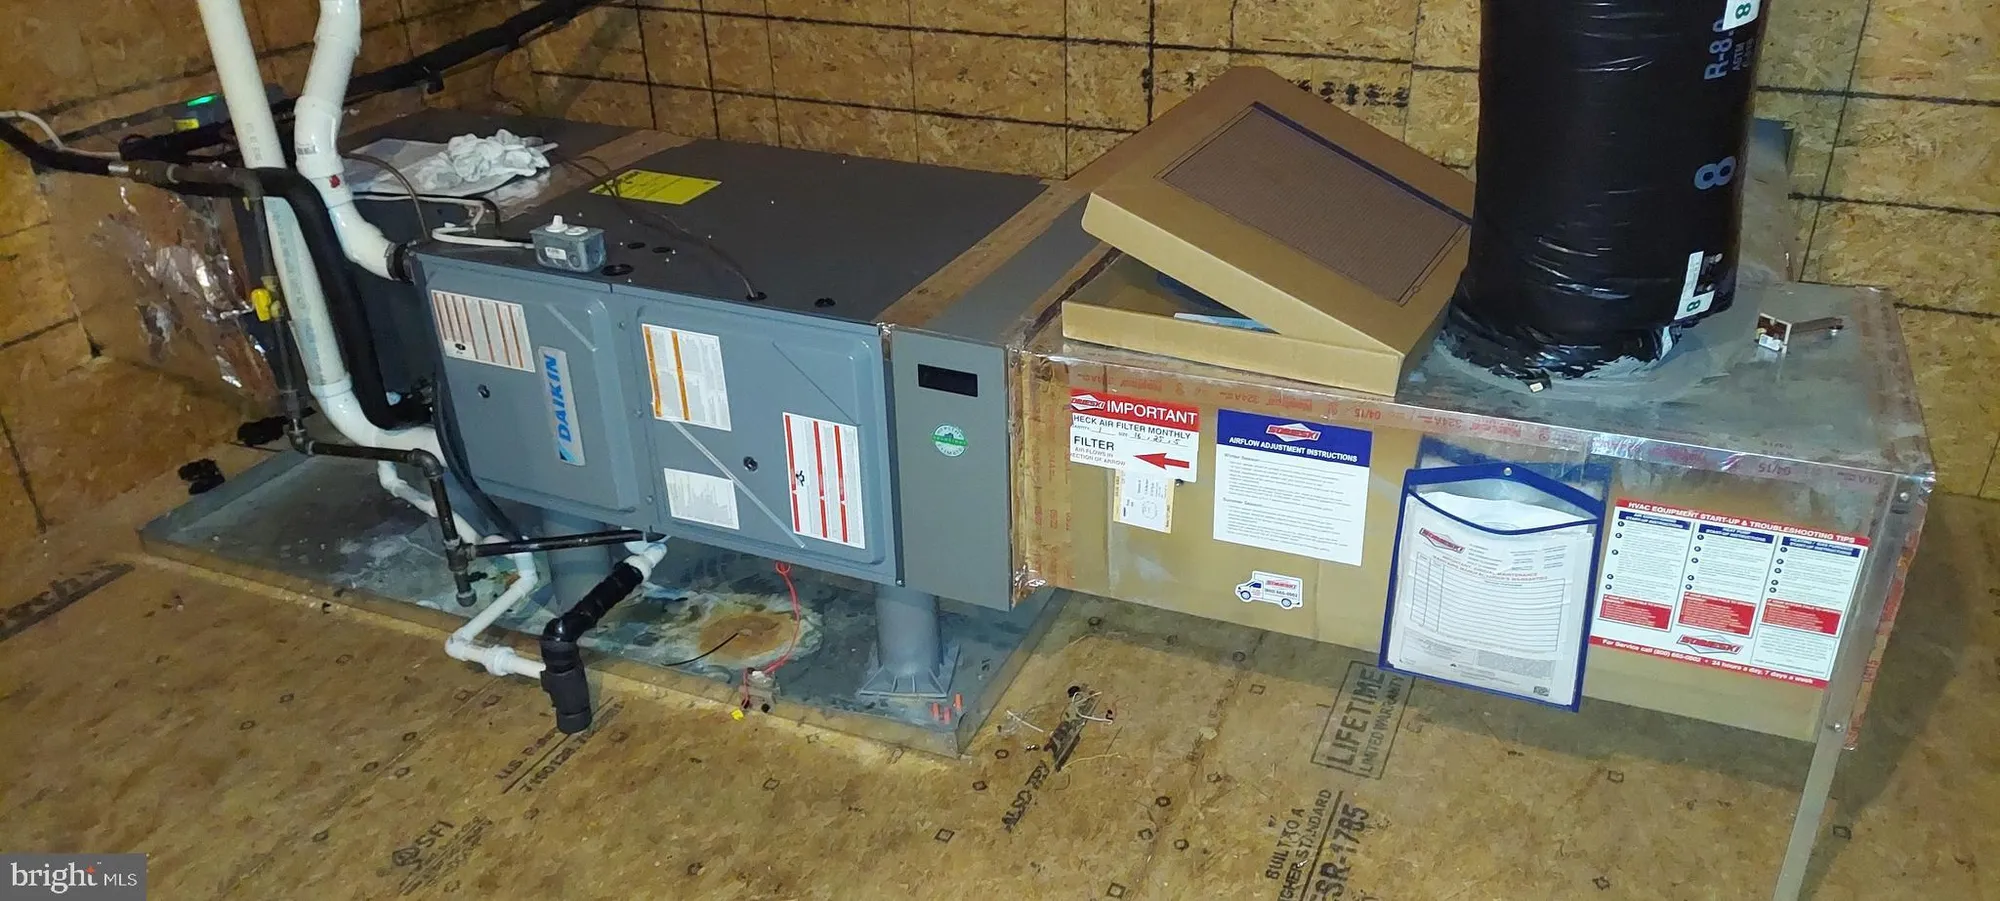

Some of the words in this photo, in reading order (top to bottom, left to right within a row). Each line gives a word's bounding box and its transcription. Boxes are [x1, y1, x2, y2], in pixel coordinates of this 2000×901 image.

[1736, 3, 1751, 19] 8
[1694, 156, 1736, 190] 8
[1687, 300, 1700, 312] 8
[543, 353, 573, 442] DAIKIN
[1107, 400, 1198, 425] IMPORTANT
[1074, 435, 1114, 451] FILTER
[1099, 419, 1114, 428] AIR
[1116, 421, 1146, 432] FILTER
[1148, 426, 1191, 440] MONTHLY
[1229, 437, 1259, 448] AIRFLOW
[1260, 441, 1306, 455] ADJUSTMENT
[1307, 448, 1358, 463] INSTRUCTIONS
[1628, 502, 1650, 511] HVAC
[1652, 505, 1699, 518] EQUIPMENT
[1700, 513, 1739, 525] START-UP
[1750, 522, 1833, 540] TROUBLESHOOTING
[1836, 534, 1855, 543] TIPS
[1615, 641, 1639, 651] Service
[1722, 662, 1742, 671] hours
[1326, 667, 1386, 766] LIFETIME
[1360, 732, 1384, 773] LIMITED
[1373, 675, 1404, 731] WARRANTY
[1296, 789, 1332, 859] STANDARD
[1265, 840, 1291, 880] BUILT
[1291, 808, 1305, 818] A
